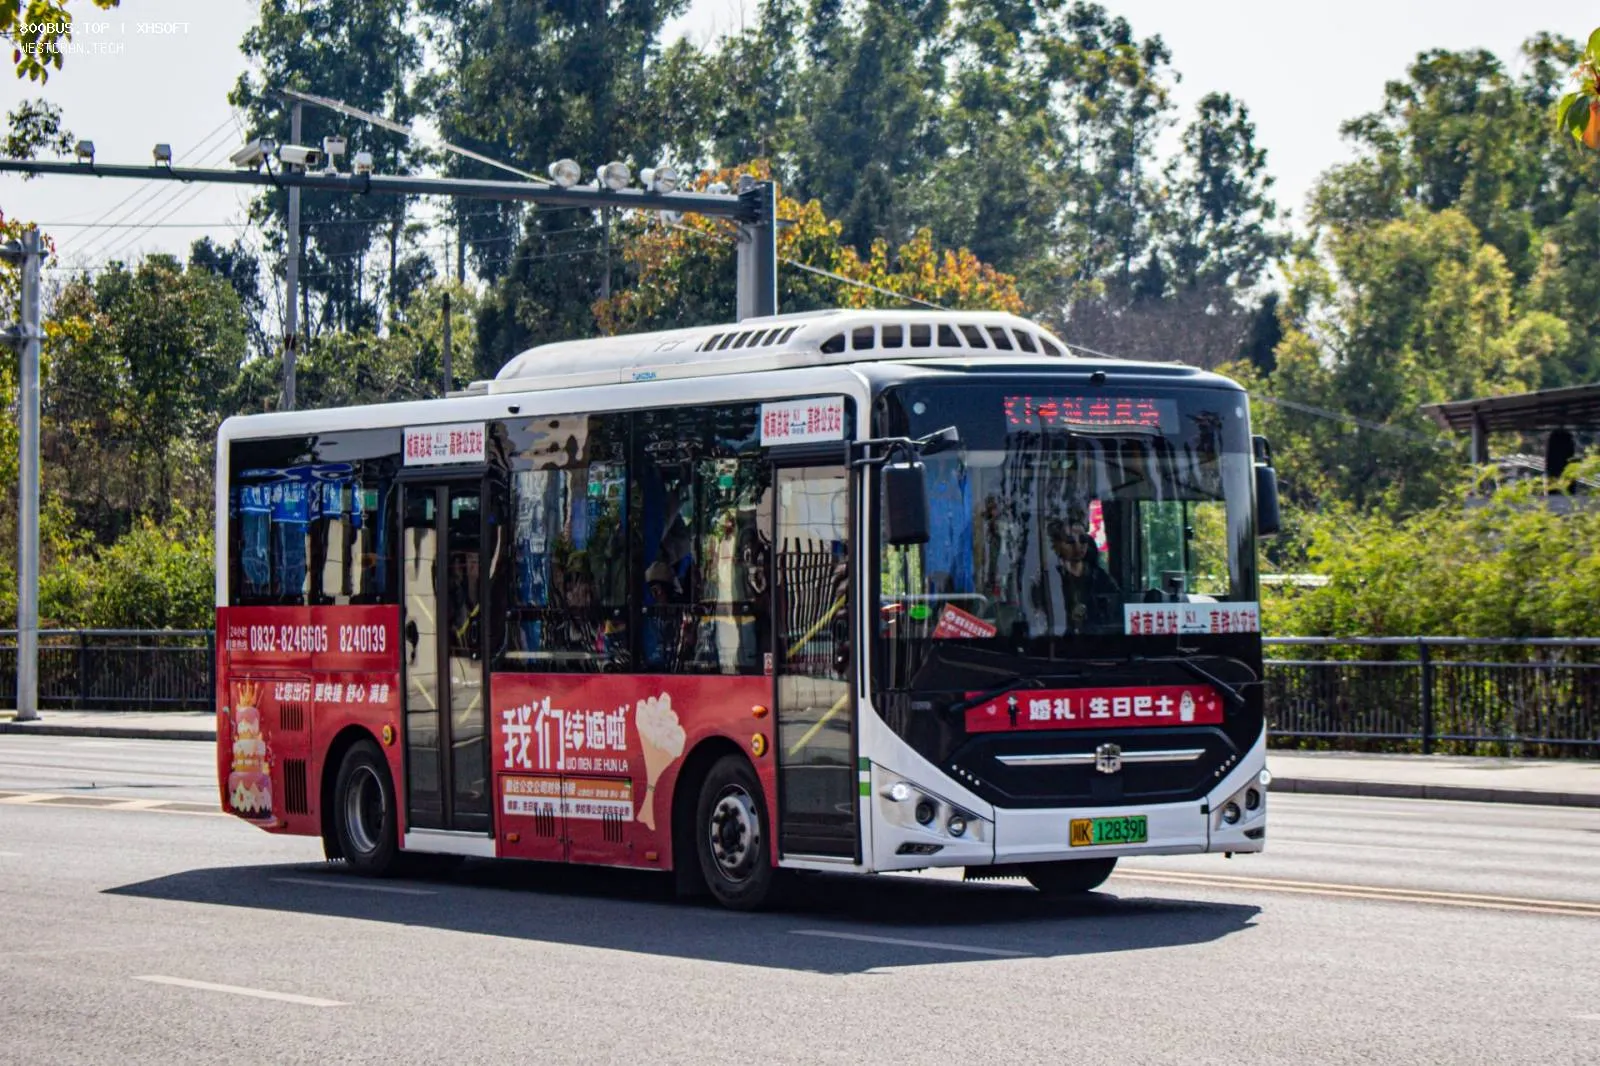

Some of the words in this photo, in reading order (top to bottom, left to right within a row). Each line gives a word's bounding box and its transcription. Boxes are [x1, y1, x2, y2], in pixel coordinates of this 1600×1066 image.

[250, 625, 328, 652] 0832-8246605
[340, 625, 386, 652] 8240139
[275, 683, 310, 702] 让您出行
[314, 683, 343, 703] 更快捷
[1029, 698, 1076, 721] 婚礼
[1089, 695, 1174, 719] 生日巴士
